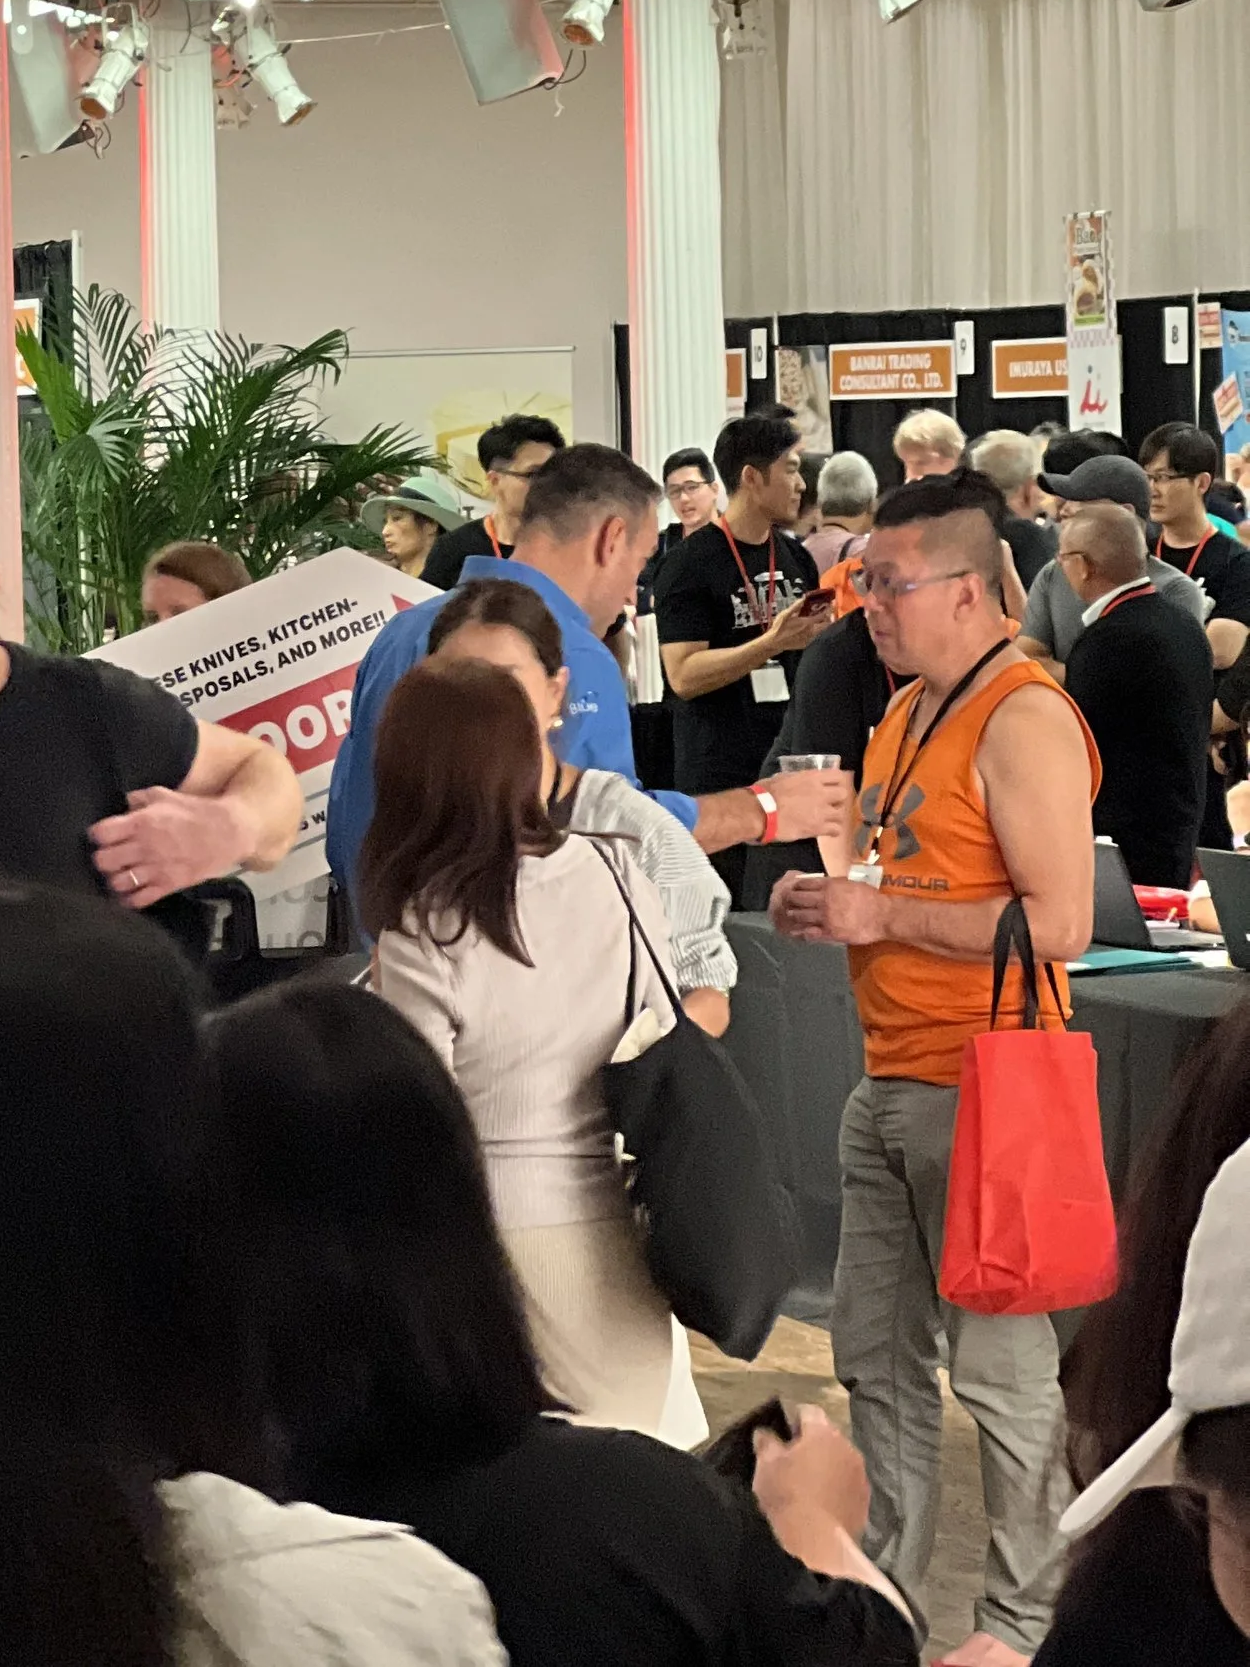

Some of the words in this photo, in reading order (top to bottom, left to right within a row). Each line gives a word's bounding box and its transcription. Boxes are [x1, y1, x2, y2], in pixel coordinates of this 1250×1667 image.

[888, 353, 932, 370] TRADING
[1009, 360, 1052, 378] IMURAYA
[839, 373, 900, 391] CONSULTANT
[924, 372, 944, 389] LTD.
[189, 636, 267, 676] KNIVES,
[267, 597, 359, 645] KITCHEN-
[278, 639, 317, 669] AND
[318, 610, 387, 650] MORE!!
